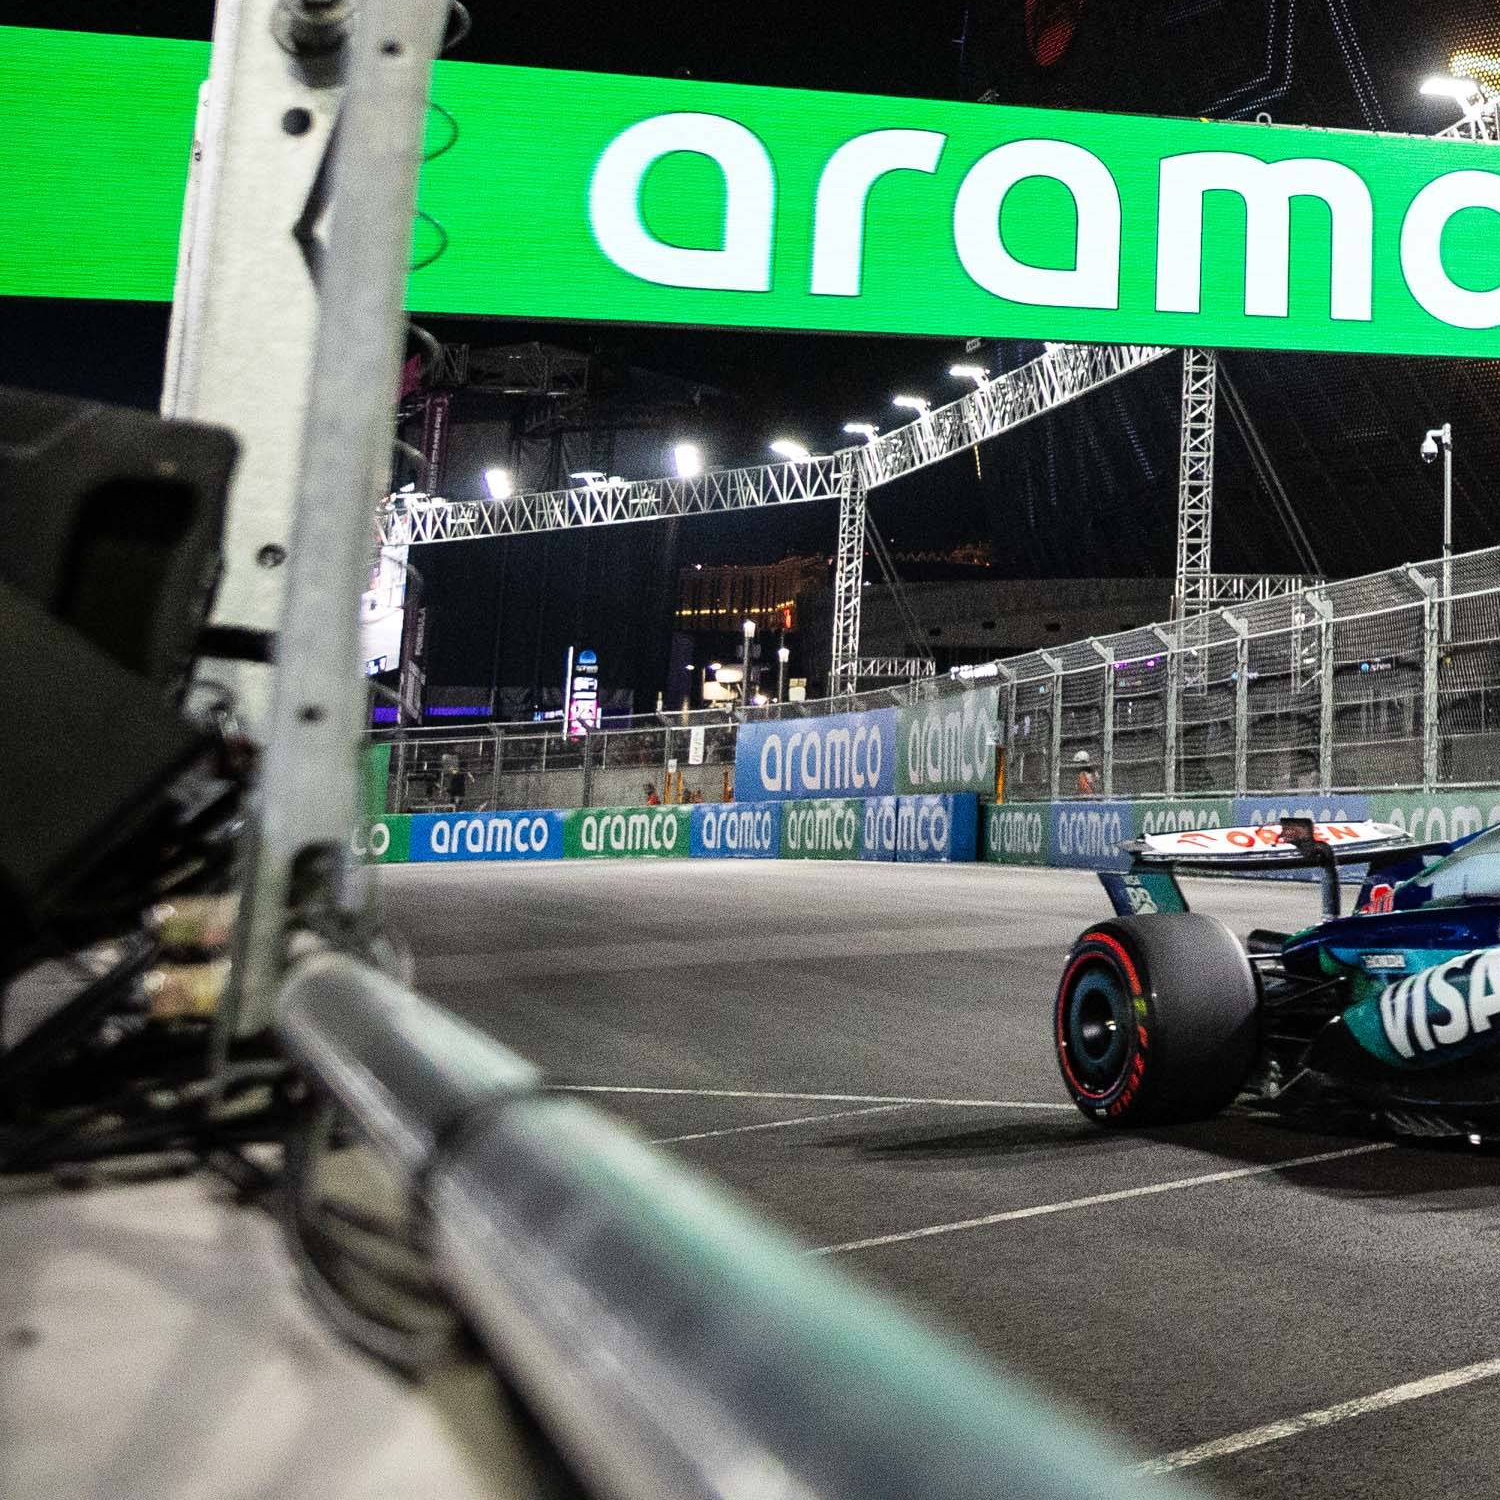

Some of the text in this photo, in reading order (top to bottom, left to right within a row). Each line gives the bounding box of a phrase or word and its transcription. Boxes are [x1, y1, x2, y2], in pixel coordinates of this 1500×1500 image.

[760, 723, 882, 792] aramco
[908, 706, 990, 786] aramco
[430, 816, 549, 854] aramco
[581, 812, 678, 851] aramco
[702, 809, 772, 850] aramco
[788, 806, 856, 851] aramco
[864, 803, 949, 851] aramco
[990, 811, 1042, 853] aramco
[1059, 810, 1121, 858] aramco
[1226, 825, 1361, 848] OREN
